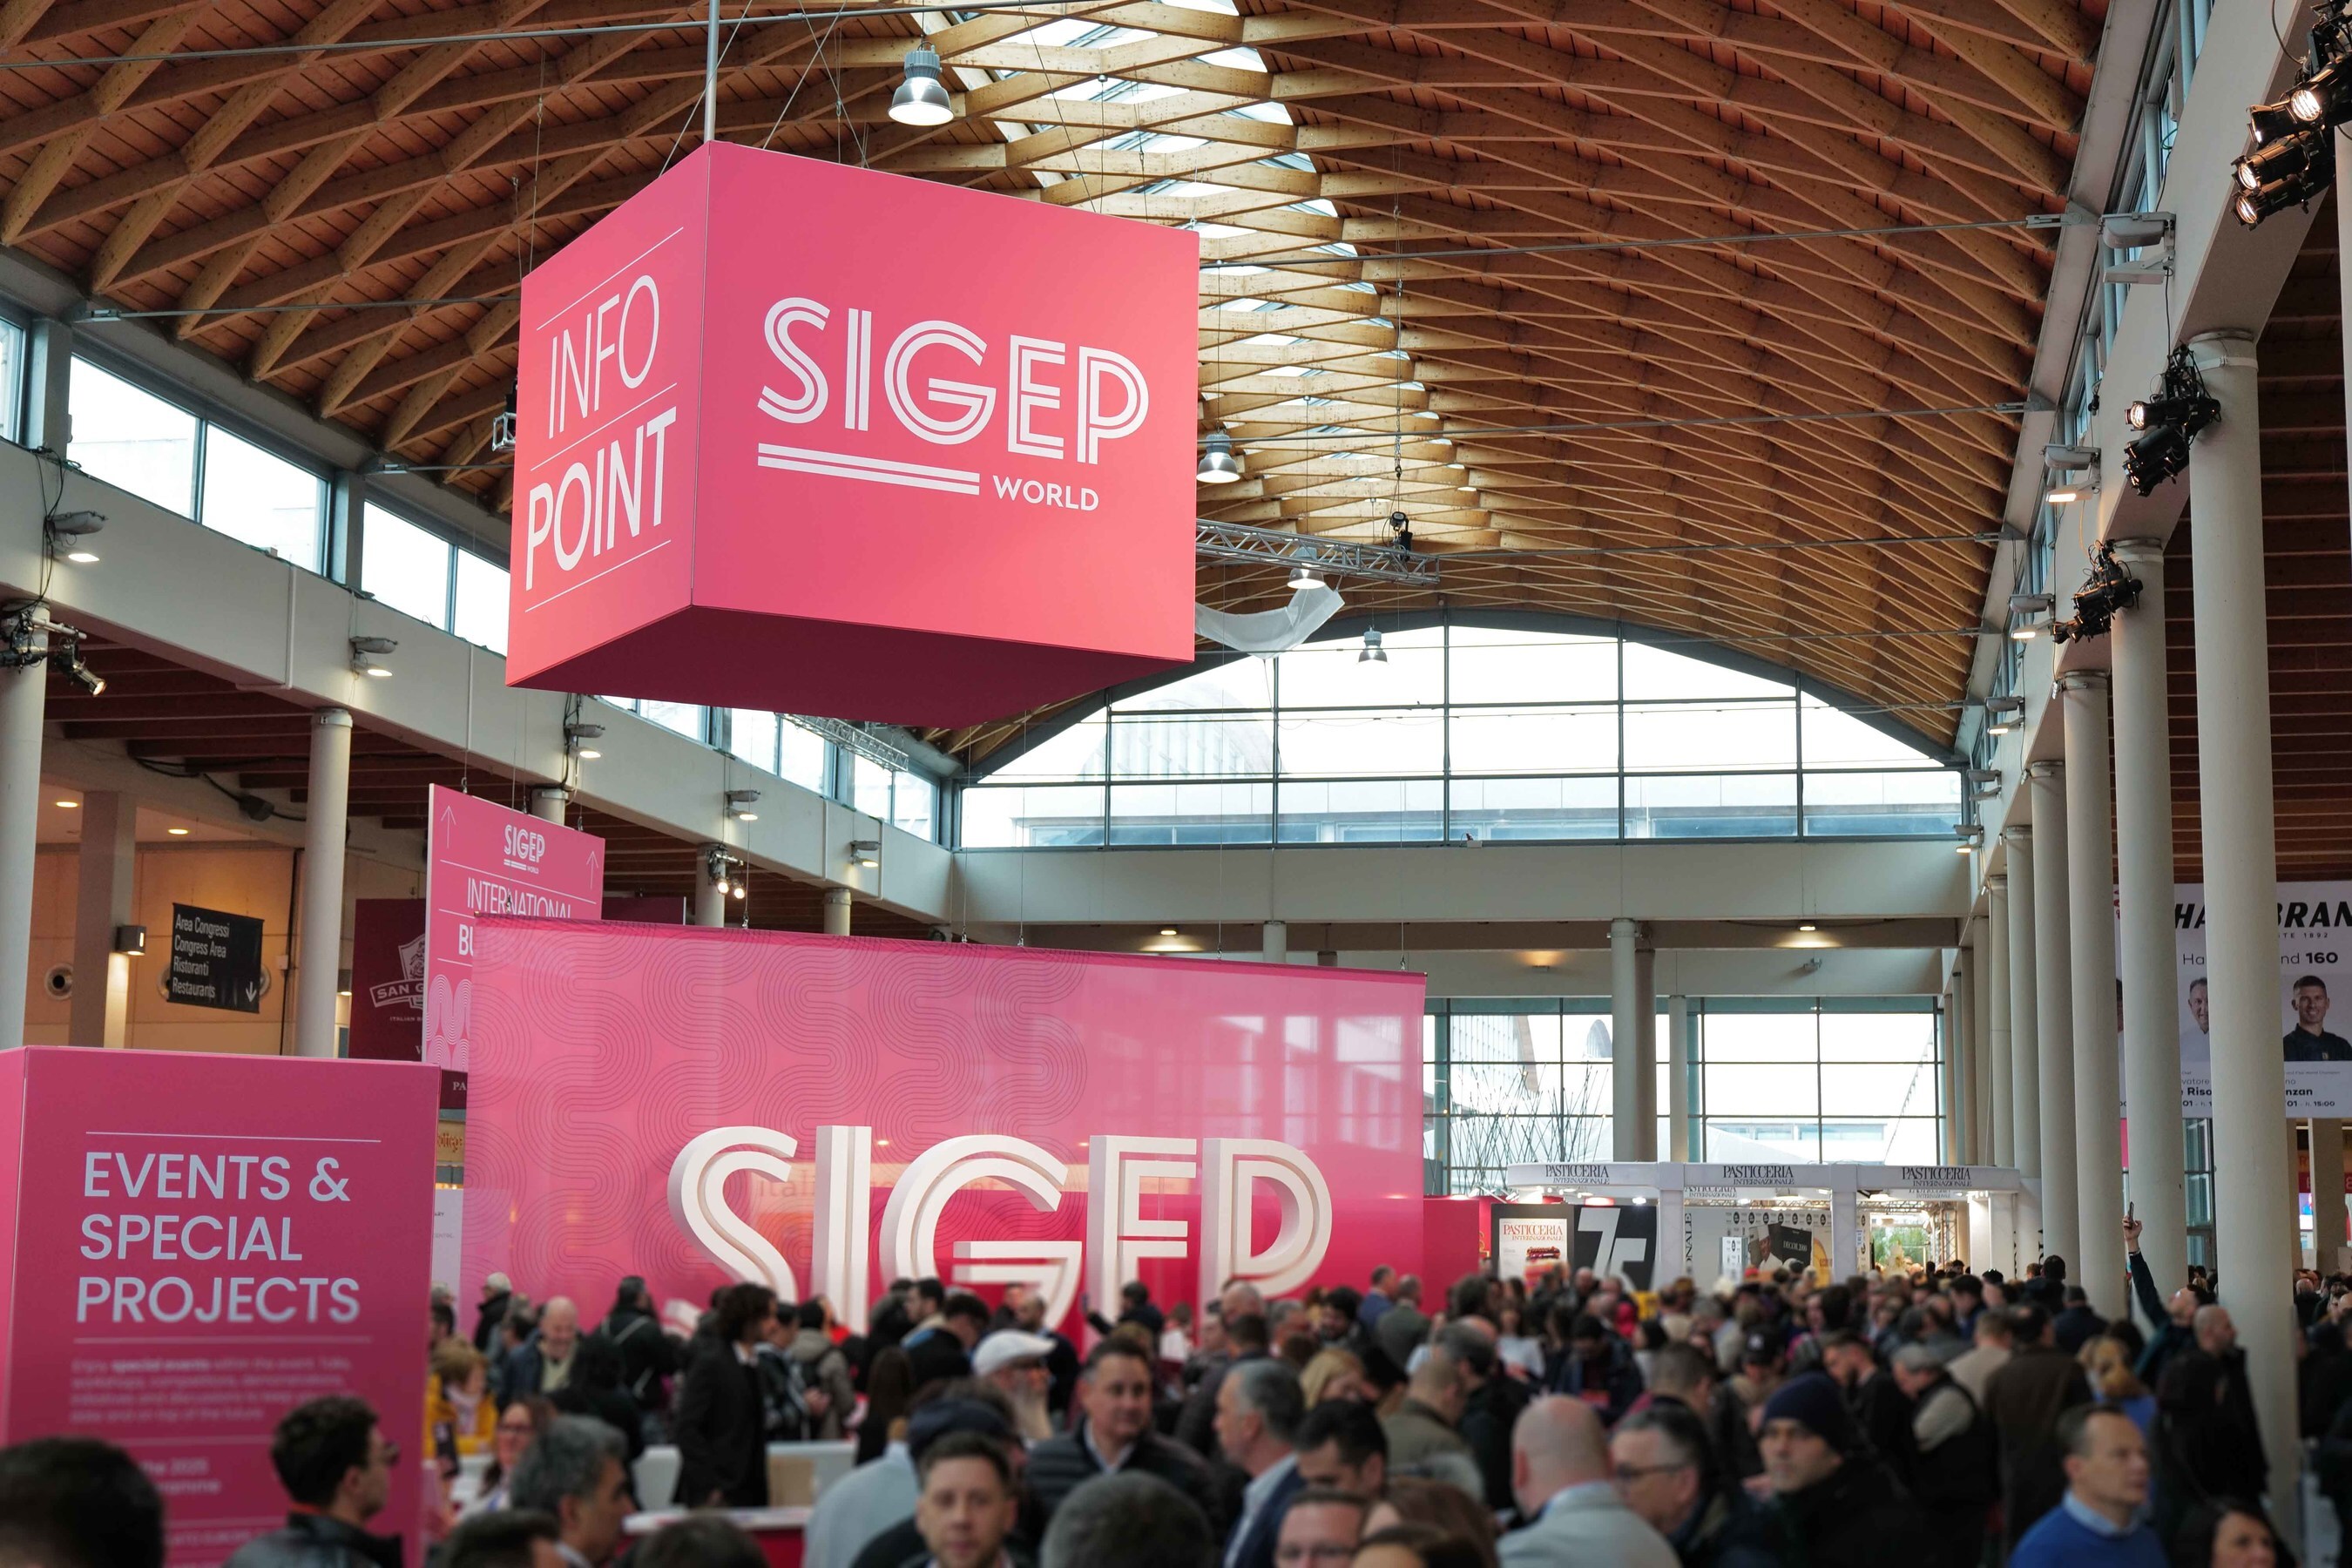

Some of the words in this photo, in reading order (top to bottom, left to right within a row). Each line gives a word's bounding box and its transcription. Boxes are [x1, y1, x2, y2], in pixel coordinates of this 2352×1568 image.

[549, 274, 659, 439] INFO
[757, 297, 1150, 465] SIGEP
[525, 406, 677, 591] POINT
[992, 475, 1100, 511] WORLD
[503, 824, 546, 863] SIGEP
[175, 914, 193, 932] Area
[193, 916, 231, 939] Congressi
[174, 935, 208, 957] Congress
[209, 941, 227, 958] Area
[2305, 951, 2339, 964] 160
[173, 956, 209, 977] Ristoranti
[172, 977, 216, 998] Restaurants
[376, 984, 410, 999] SAN
[84, 1152, 291, 1201] EVENTS
[308, 1157, 351, 1202] &
[1545, 1165, 1610, 1178] PASTICCERIA
[1723, 1166, 1794, 1179] PASTICCERIA
[1903, 1166, 1971, 1180] PASTICCERIA
[80, 1213, 303, 1261] SPECIAL
[1503, 1224, 1564, 1236] PASTICCERIA
[77, 1276, 361, 1324] PROJECTS
